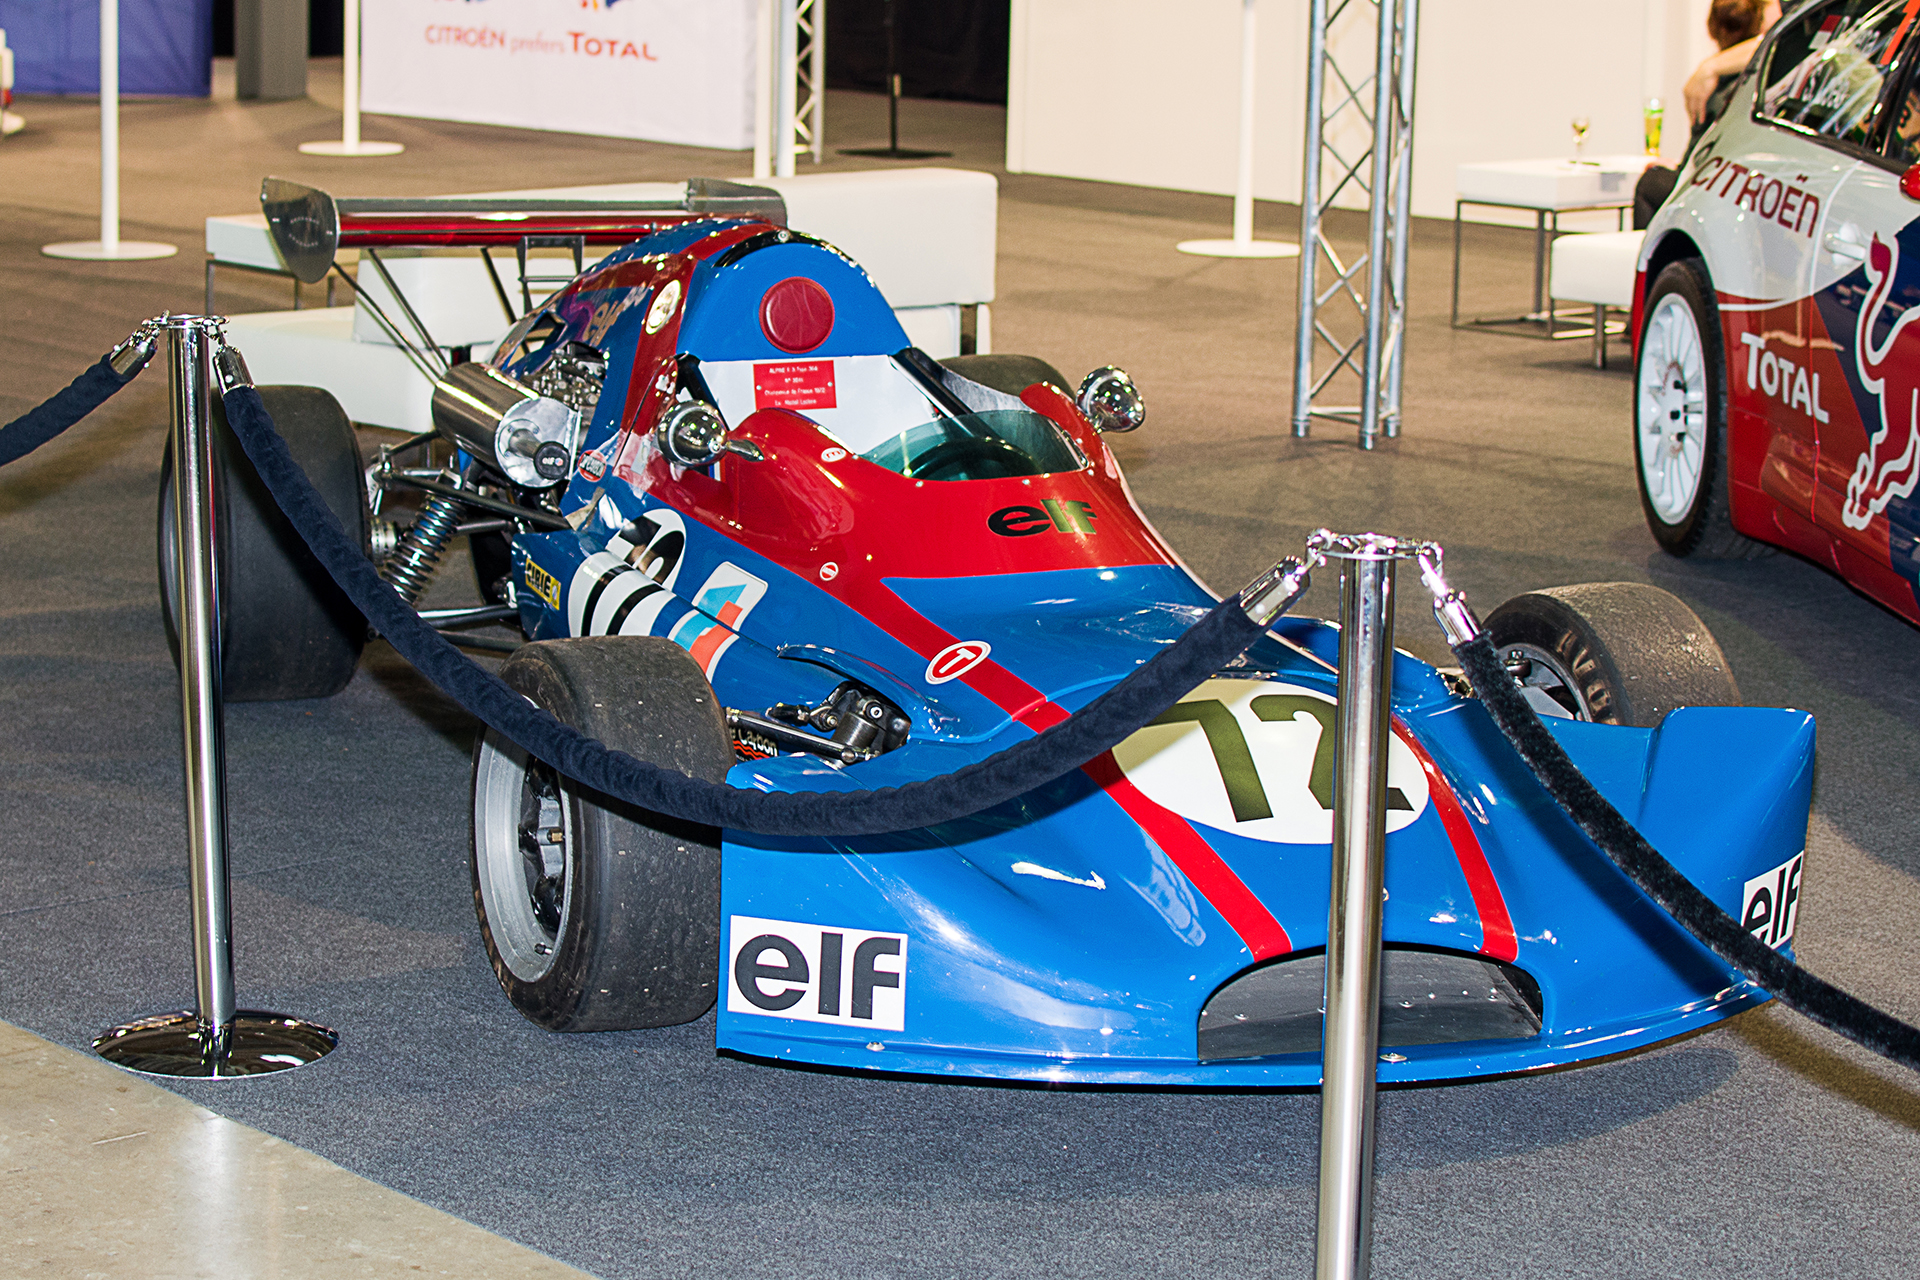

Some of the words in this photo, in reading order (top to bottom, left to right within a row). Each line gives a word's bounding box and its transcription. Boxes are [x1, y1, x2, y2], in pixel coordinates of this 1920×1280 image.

[425, 23, 505, 48] CITROËN
[510, 30, 565, 55] prefers
[567, 31, 658, 62] TOTAL
[1691, 156, 1819, 238] CITROËN
[1741, 331, 1829, 424] TOTAL
[987, 499, 1098, 537] elf
[1743, 855, 1803, 945] elf
[734, 931, 900, 1020] elf
